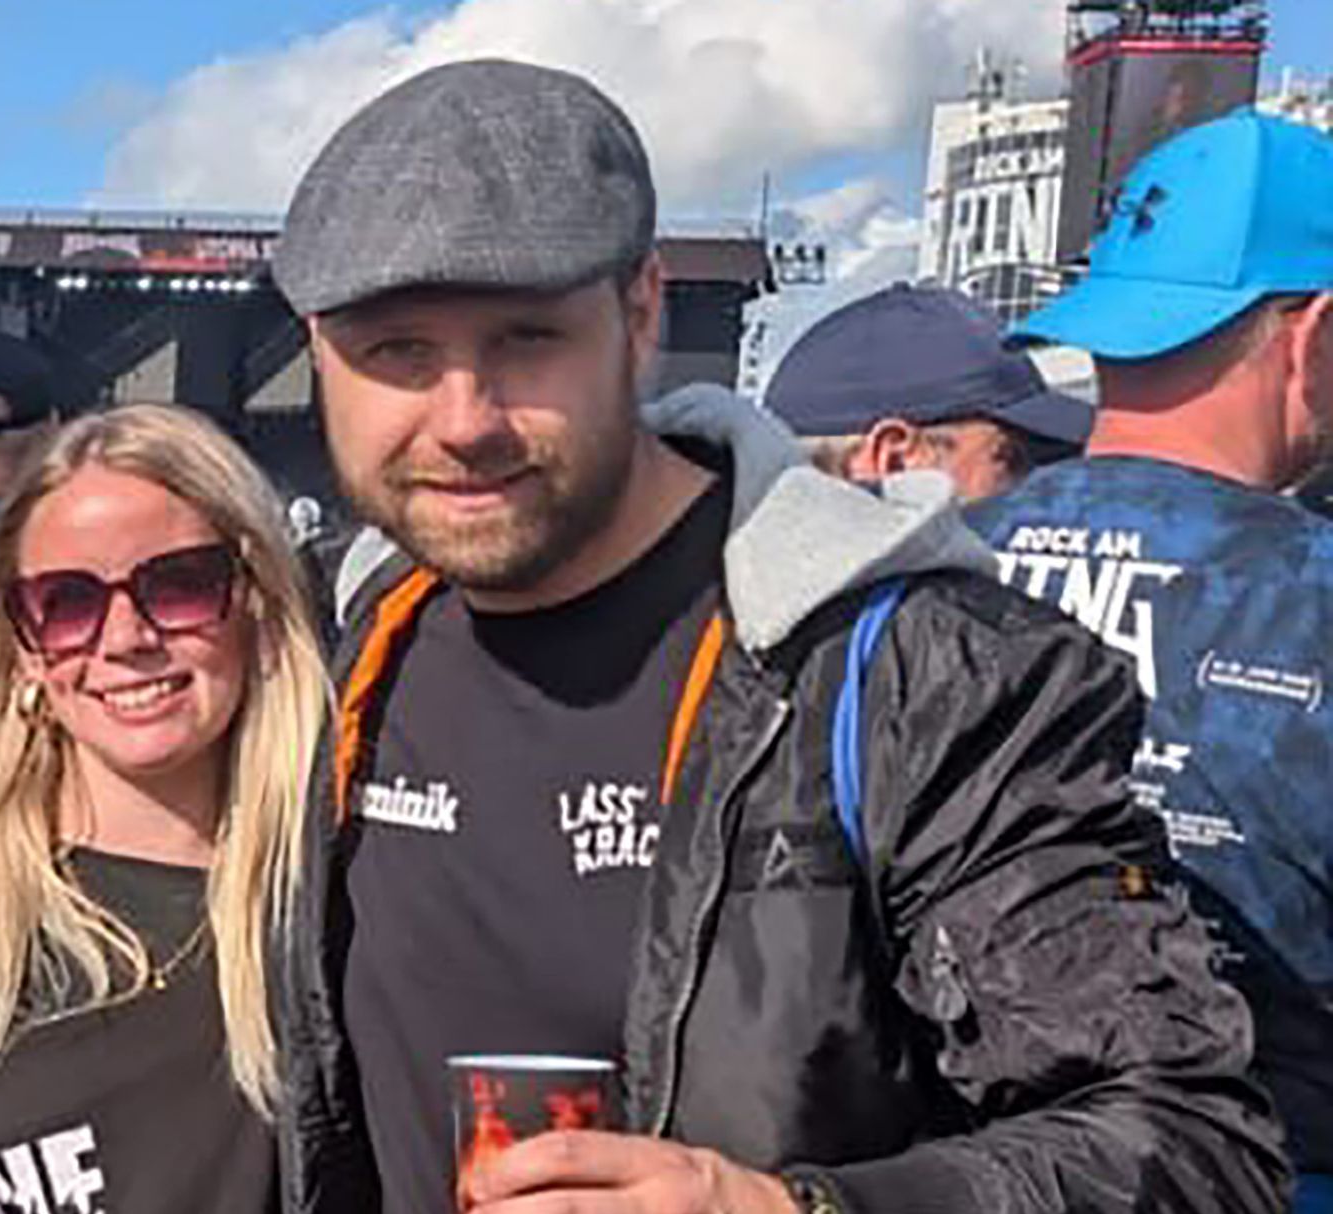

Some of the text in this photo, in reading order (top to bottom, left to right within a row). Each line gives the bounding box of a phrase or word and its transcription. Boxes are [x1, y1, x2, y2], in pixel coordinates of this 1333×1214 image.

[1008, 526, 1141, 558] ROCK AM
[994, 552, 1183, 700] ING
[573, 823, 661, 876] KRAC
